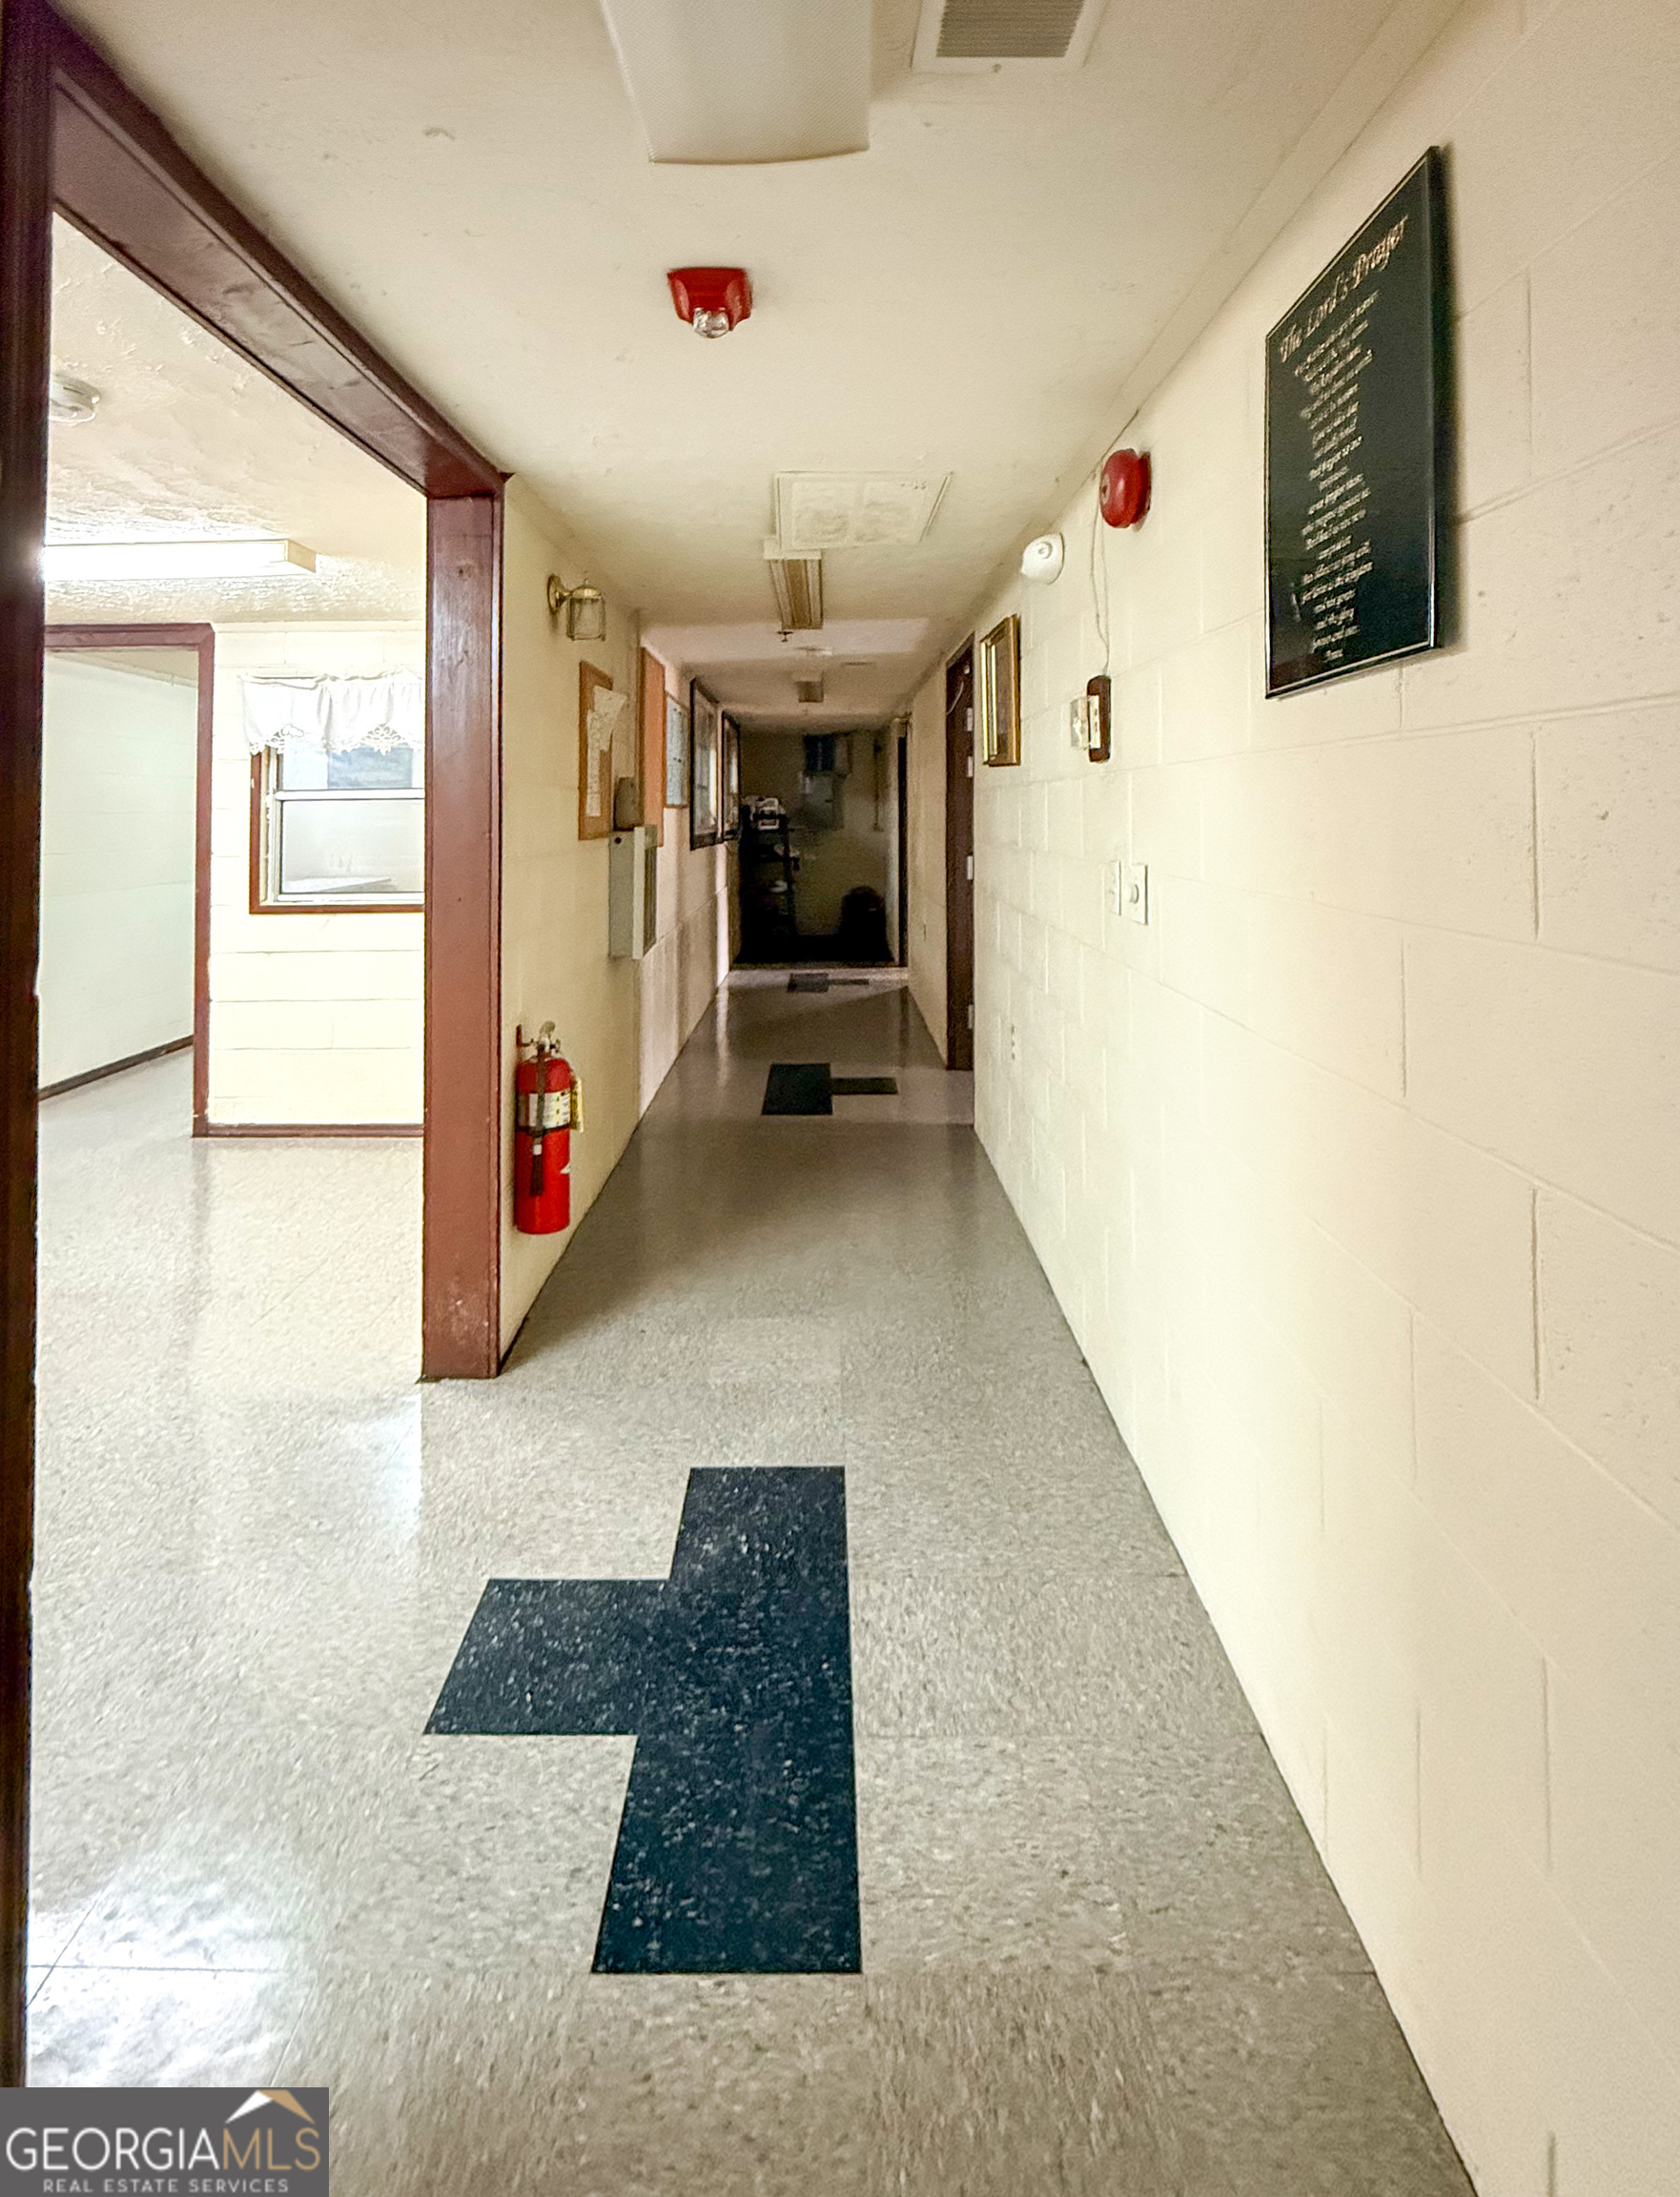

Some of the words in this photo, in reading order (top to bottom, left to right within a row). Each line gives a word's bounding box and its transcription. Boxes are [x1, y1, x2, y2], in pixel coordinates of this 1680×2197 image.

[1280, 323, 1303, 363] The
[1306, 272, 1349, 338] Lord's
[1351, 215, 1409, 290] Prayer
